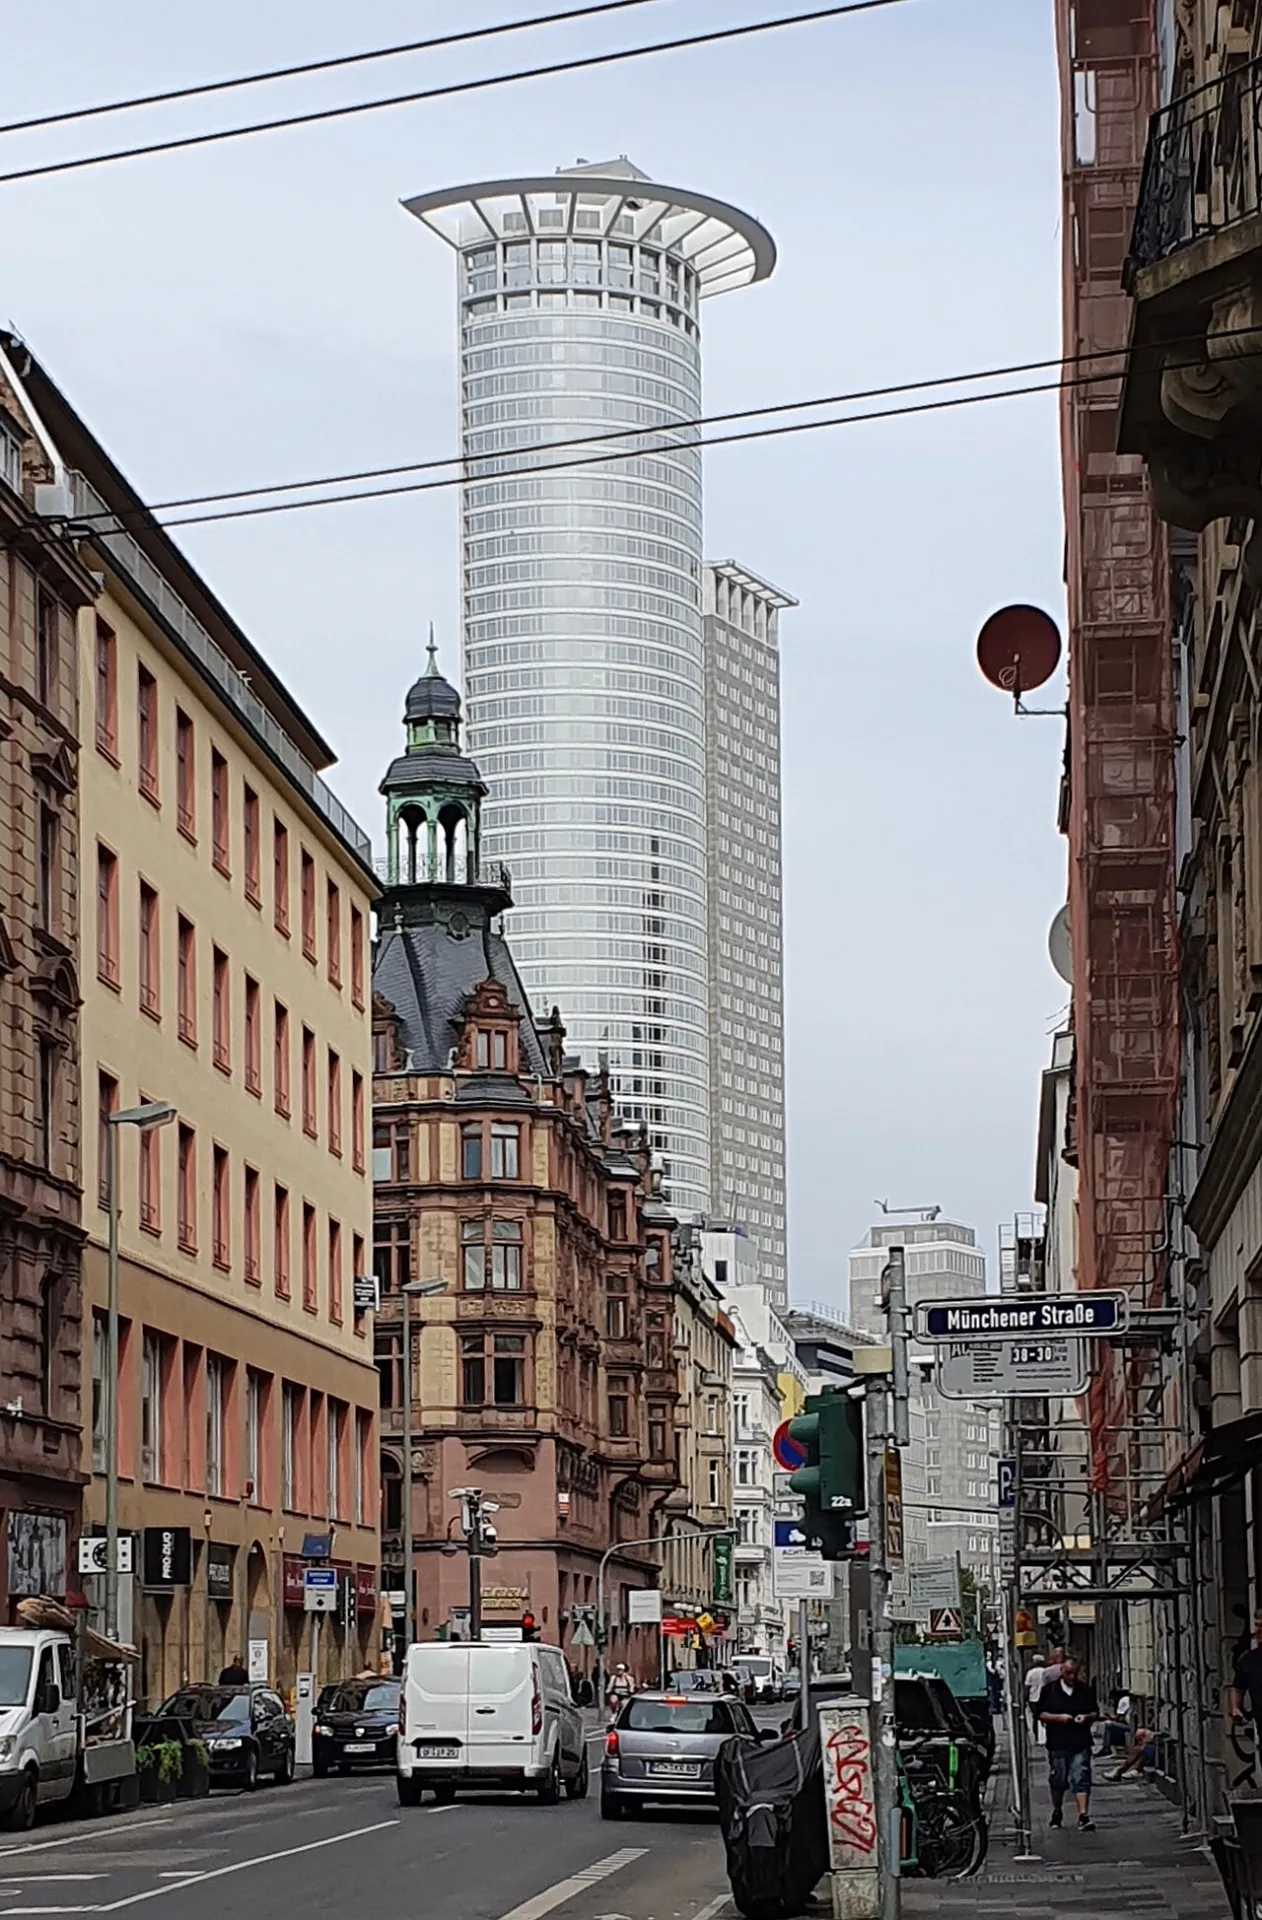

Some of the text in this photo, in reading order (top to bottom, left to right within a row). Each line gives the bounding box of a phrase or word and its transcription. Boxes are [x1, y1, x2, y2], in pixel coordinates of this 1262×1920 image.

[947, 1303, 1095, 1331] Münchener Straße
[831, 1495, 853, 1508] 22a
